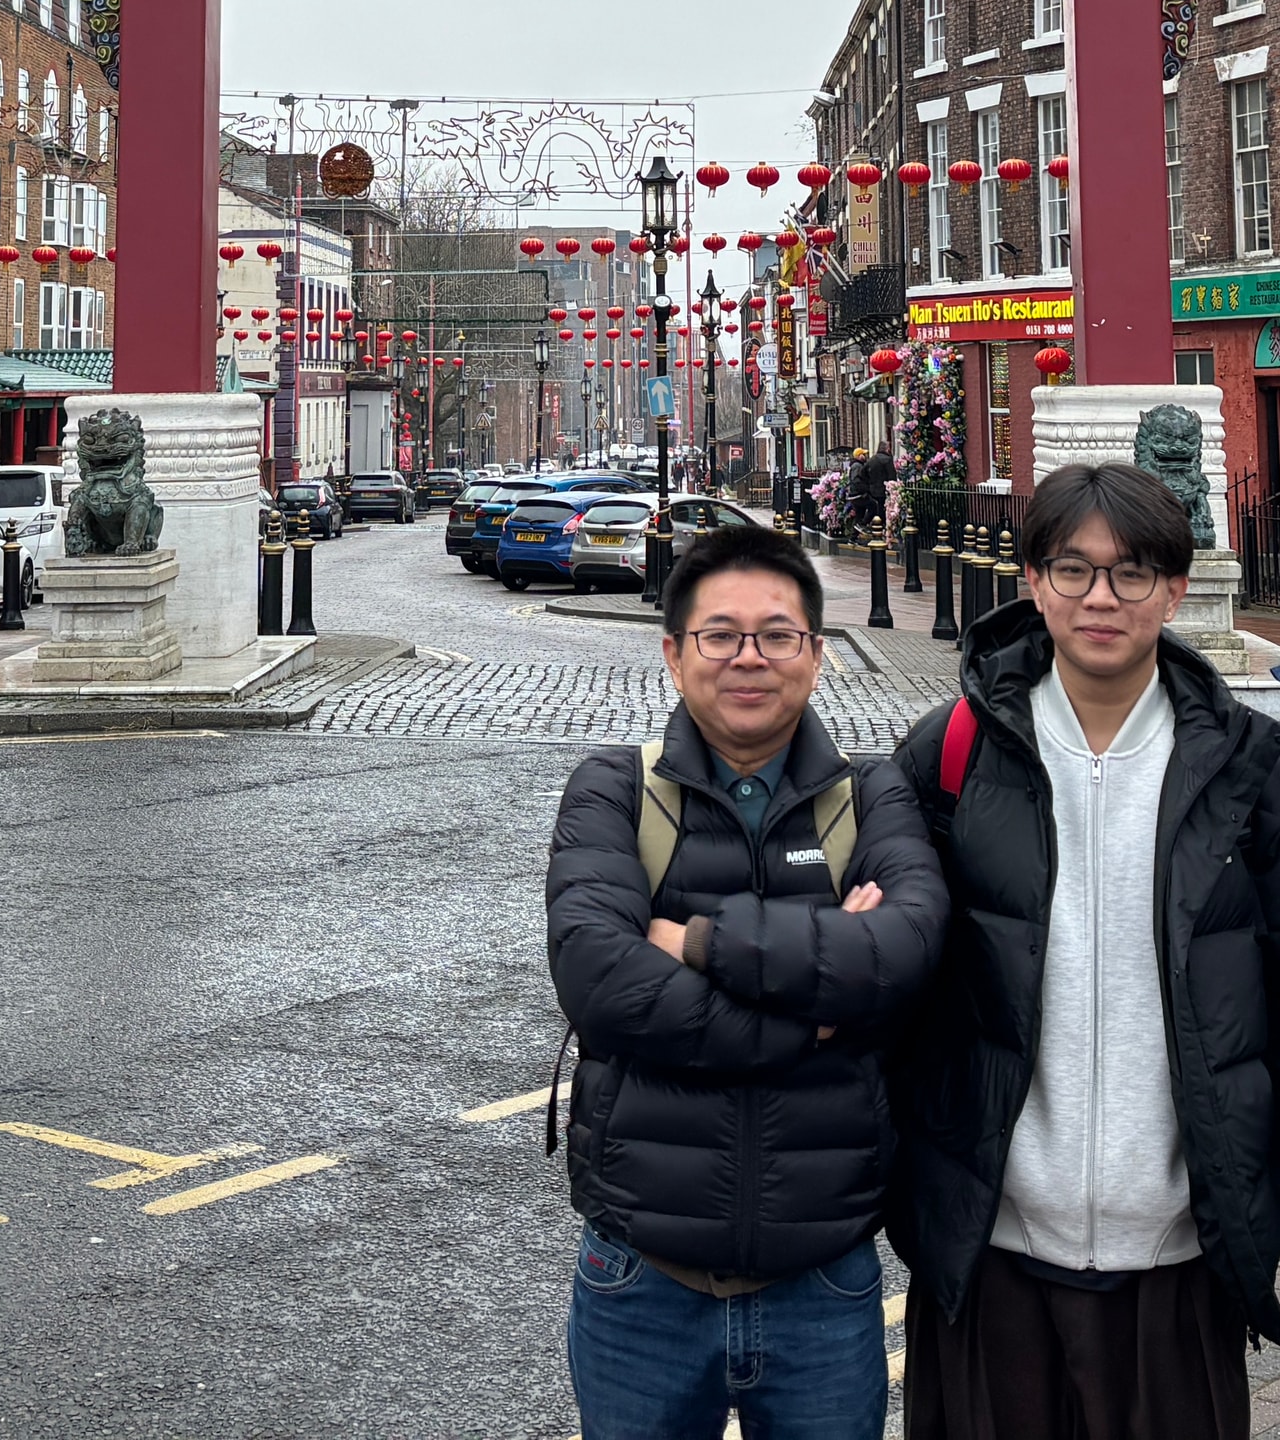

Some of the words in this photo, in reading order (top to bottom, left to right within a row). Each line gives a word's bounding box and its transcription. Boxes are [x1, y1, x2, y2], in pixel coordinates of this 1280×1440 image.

[1256, 279, 1280, 292] CHINESE
[910, 303, 933, 324] Man
[935, 302, 970, 323] Tsuen
[973, 299, 1000, 320] Ho's
[1003, 296, 1075, 320] Restaurant
[1025, 325, 1041, 335] 0151
[1043, 325, 1056, 335] 708
[1057, 323, 1073, 334] 4900
